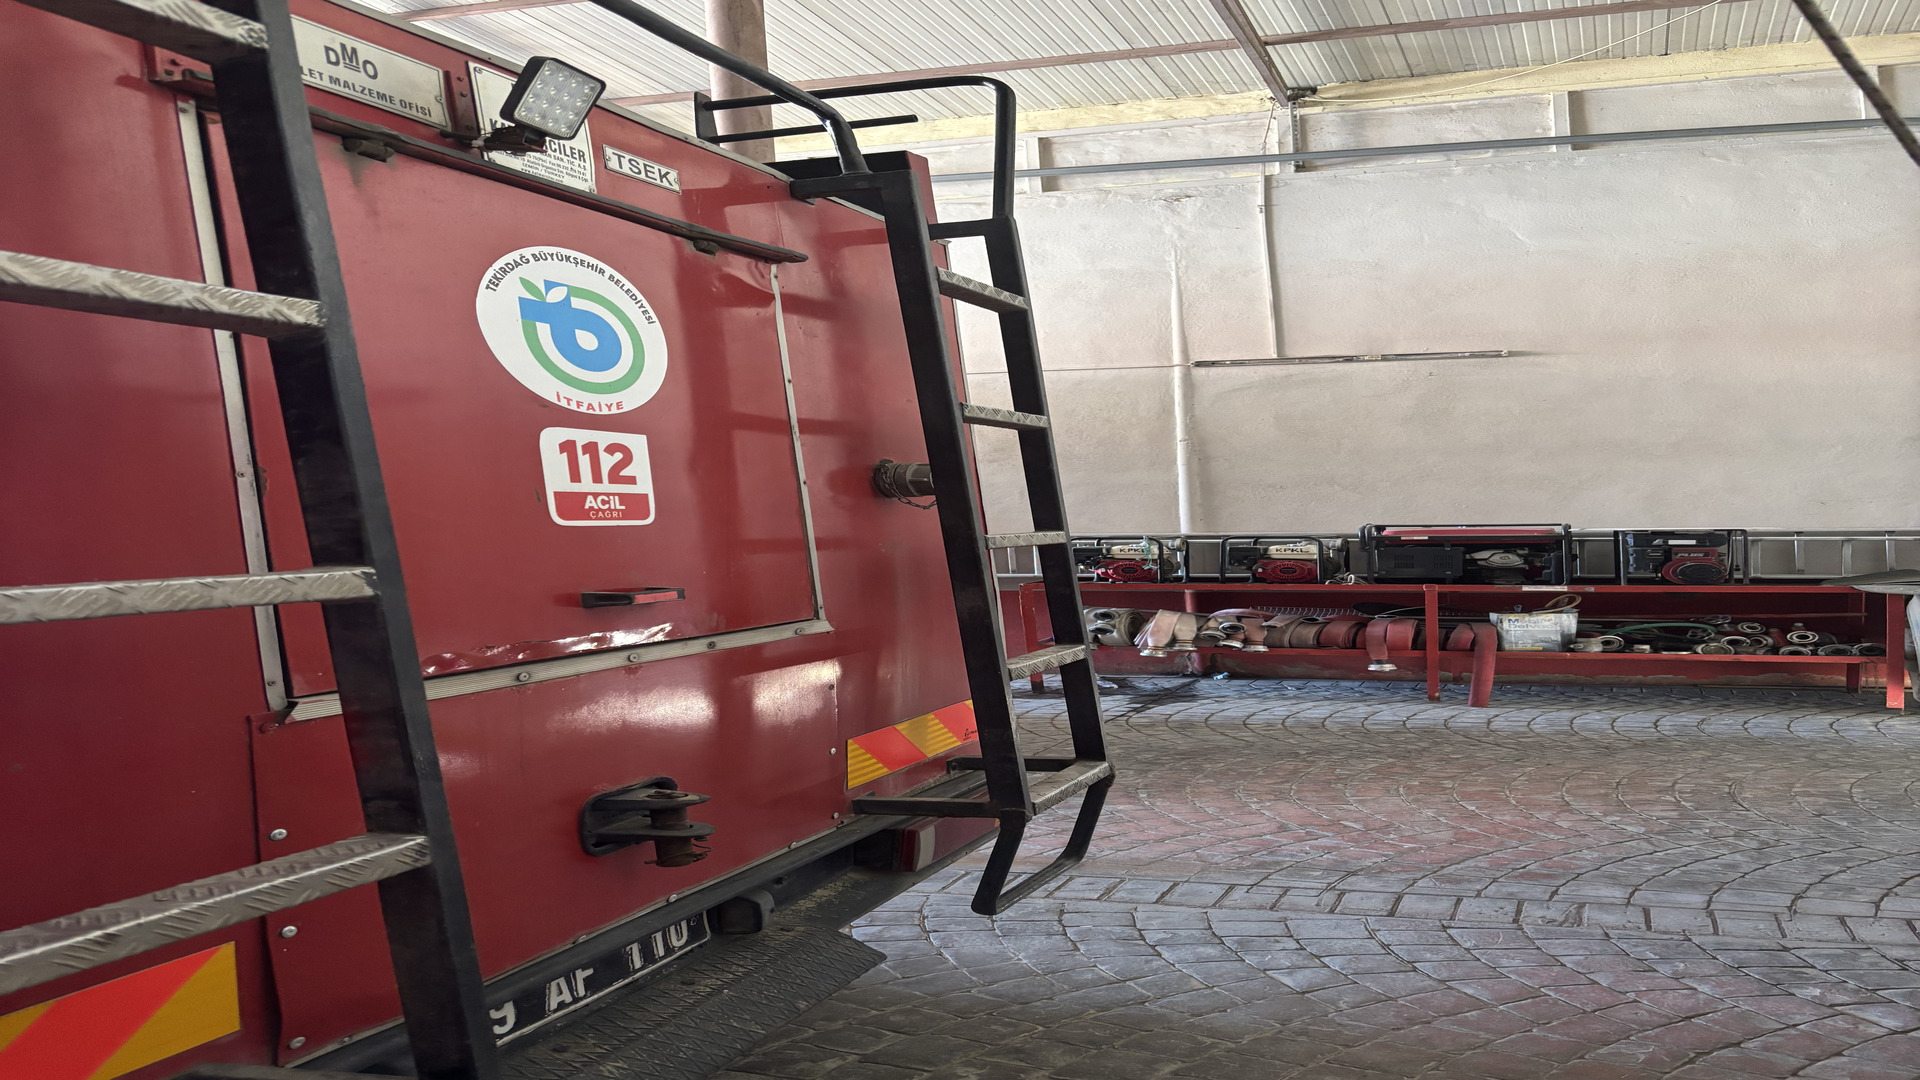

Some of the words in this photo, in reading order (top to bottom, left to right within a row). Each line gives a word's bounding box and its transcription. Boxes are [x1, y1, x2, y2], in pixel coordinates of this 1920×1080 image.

[324, 42, 378, 80] DMO
[300, 66, 324, 81] LET
[328, 75, 396, 105] MALZEME
[399, 98, 432, 118] OFİSİ
[612, 151, 674, 187] TSEK
[485, 252, 531, 293] TEKİRDAĞ
[531, 250, 606, 277] BÜYÜKŞEHİR
[608, 273, 657, 325] BELEDİYESİ
[555, 391, 625, 412] İTFAİYE
[558, 439, 638, 486] 112
[584, 495, 626, 510] ACİL
[589, 510, 623, 519] ÇAĞRI
[489, 1000, 516, 1035] 9
